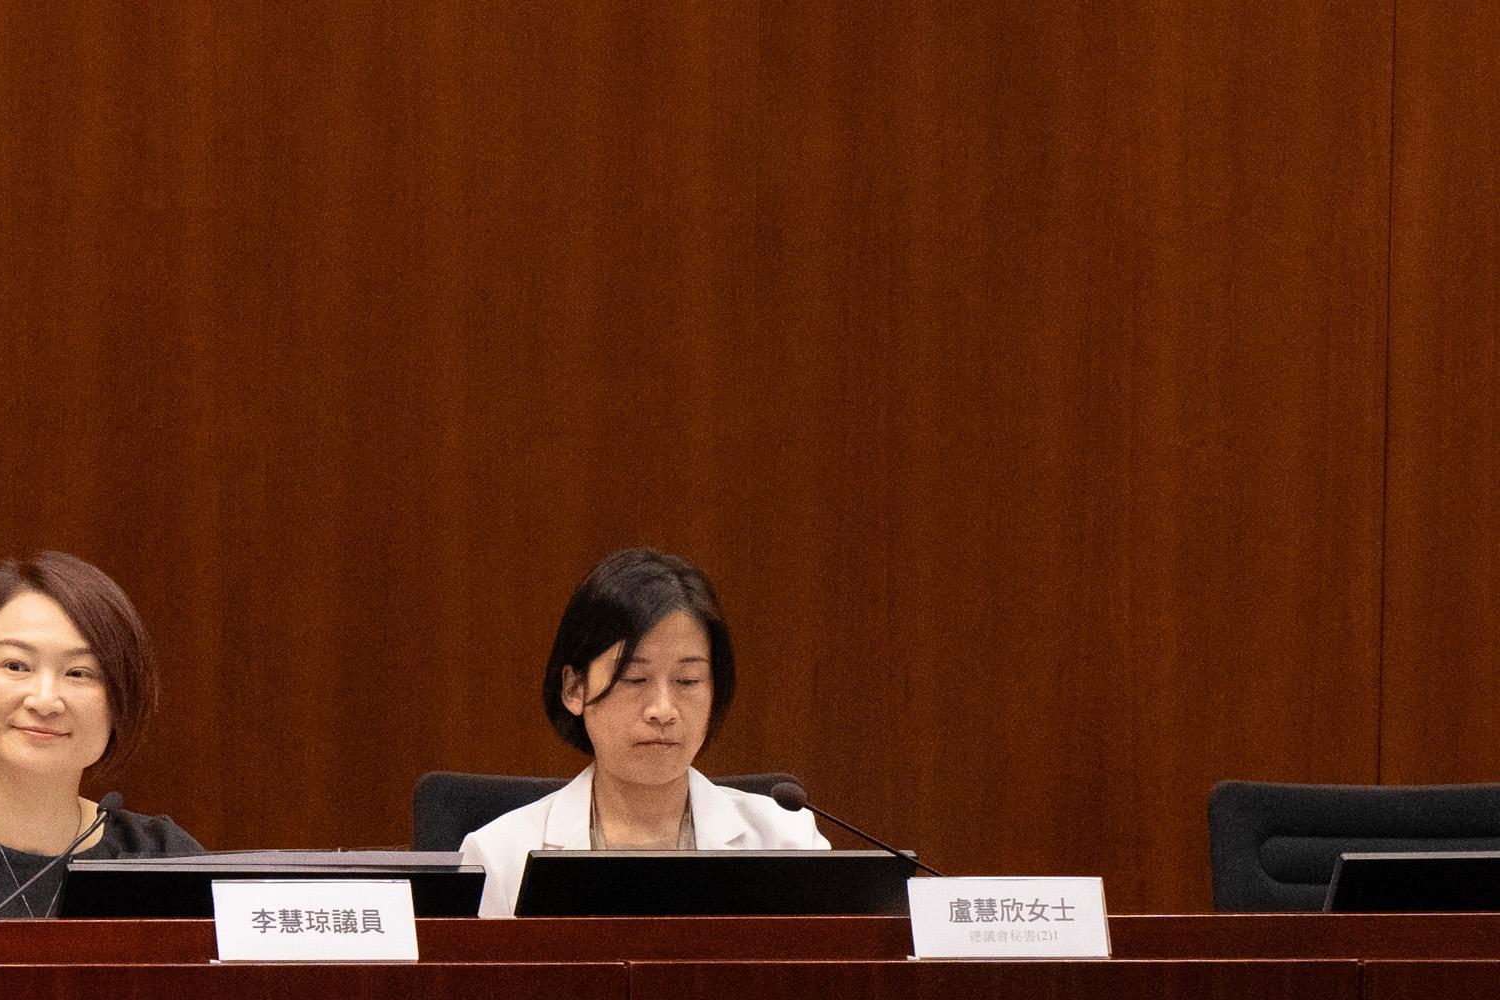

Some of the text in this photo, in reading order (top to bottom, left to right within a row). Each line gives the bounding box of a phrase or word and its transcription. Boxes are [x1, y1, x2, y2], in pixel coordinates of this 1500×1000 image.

[251, 908, 385, 934] 李慧琼議員
[949, 898, 1076, 923] 盧慧欣女士
